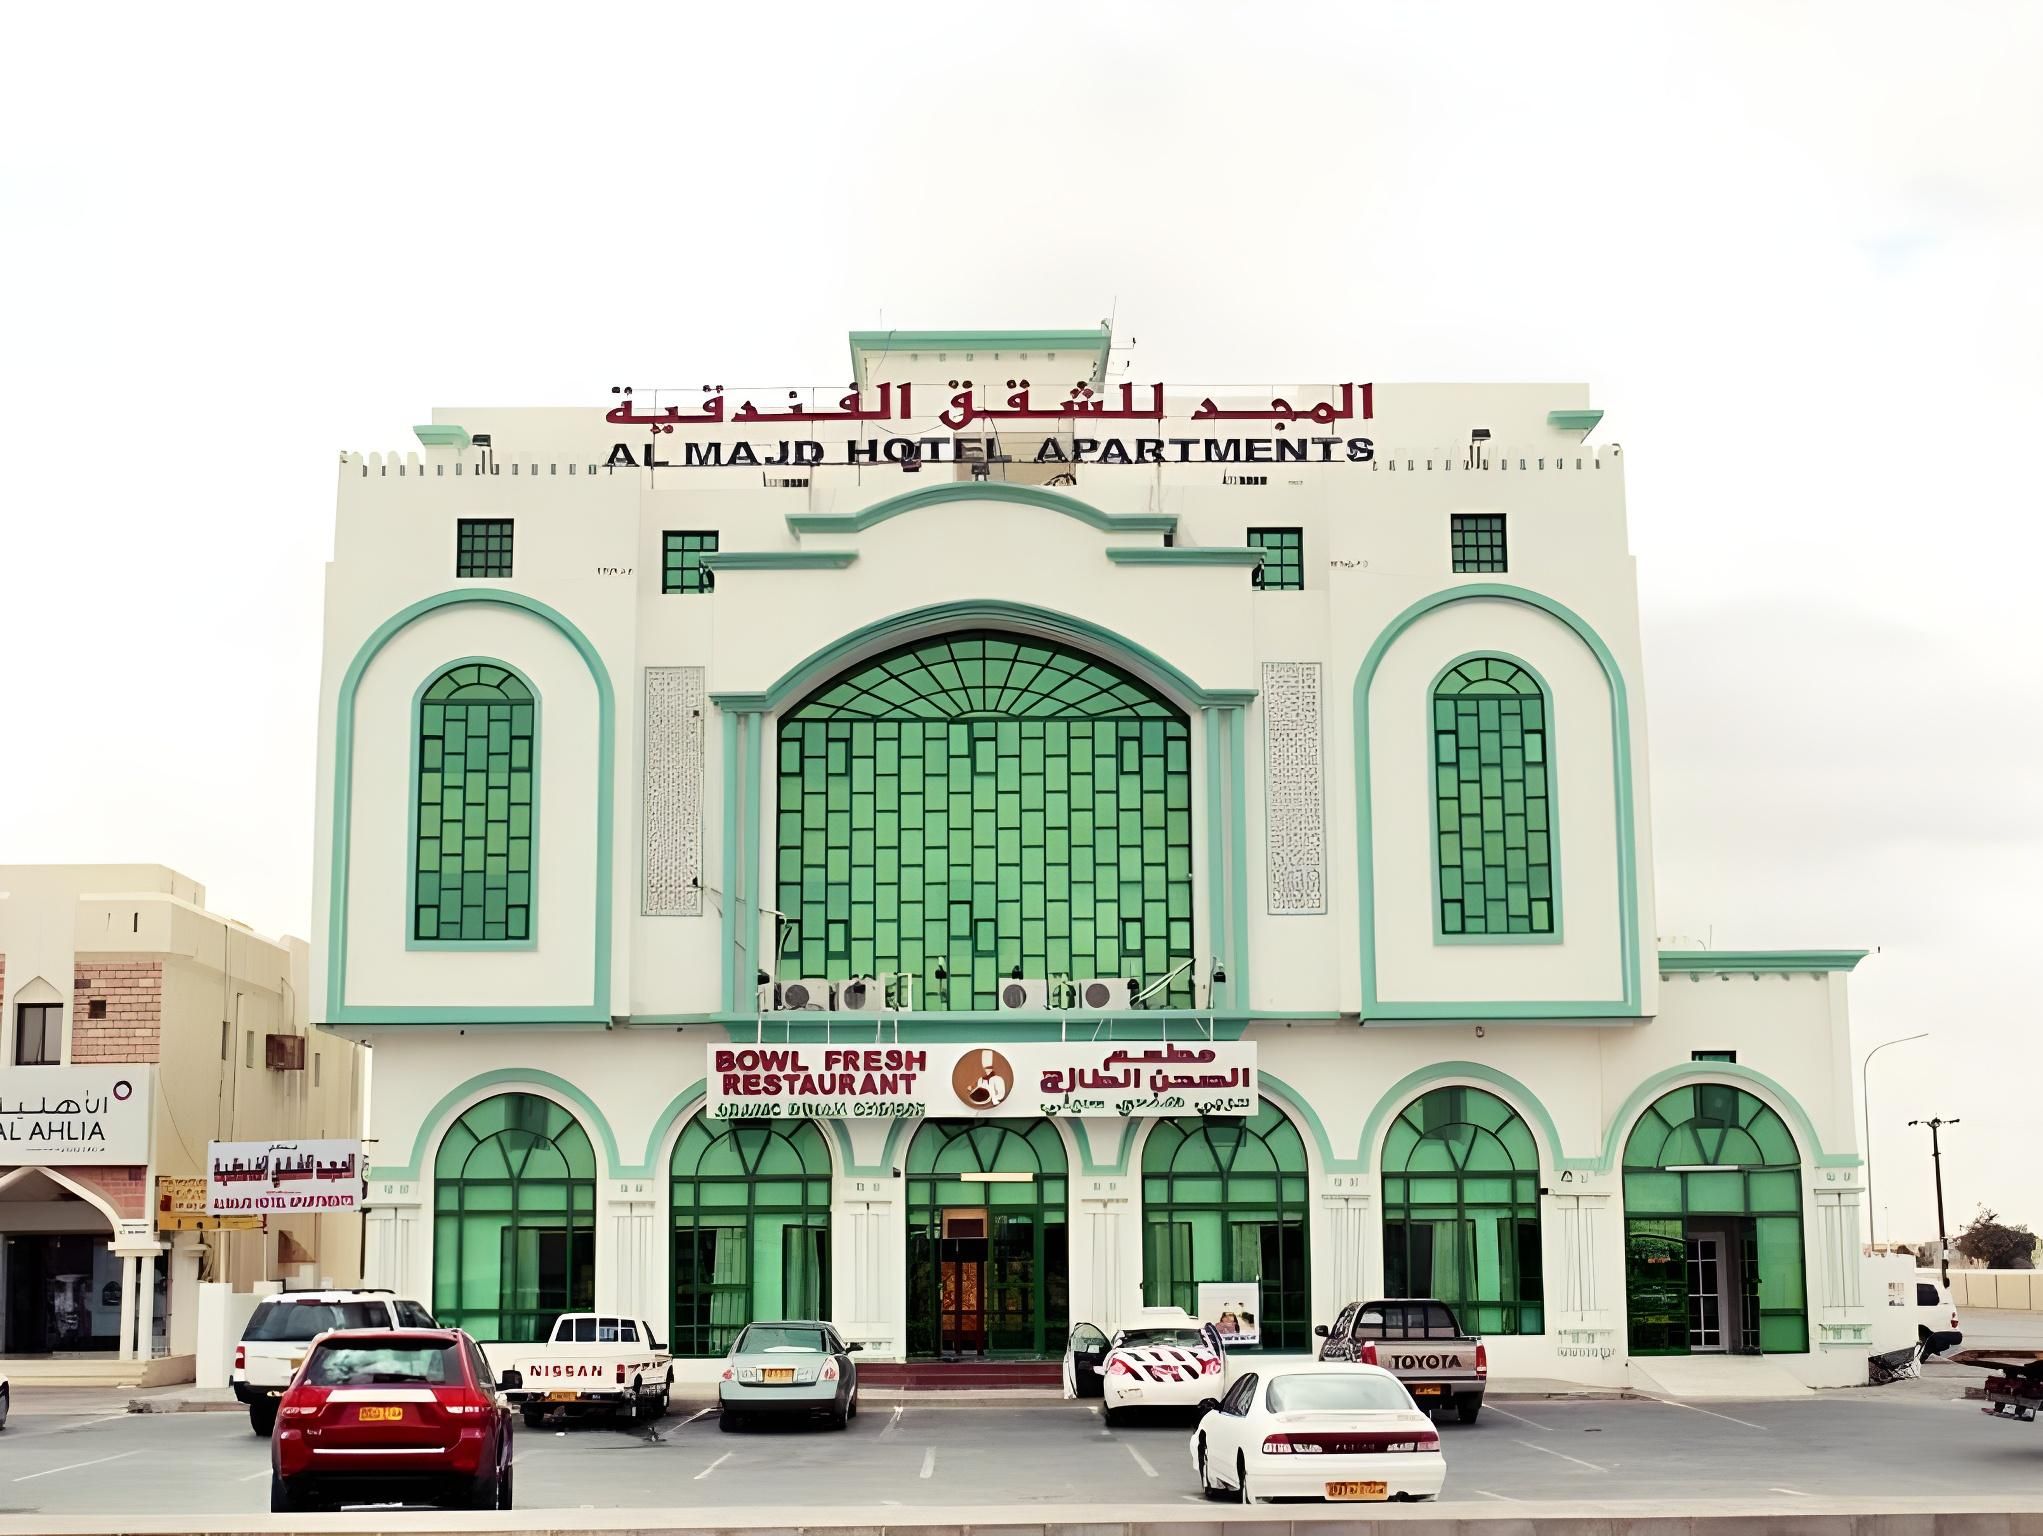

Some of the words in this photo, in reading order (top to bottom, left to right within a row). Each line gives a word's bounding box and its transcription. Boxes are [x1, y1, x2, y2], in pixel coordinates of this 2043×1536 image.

[606, 382, 911, 434] الفندقية
[938, 380, 1168, 430] للشقق
[1191, 382, 1373, 431] المجد
[606, 443, 669, 466] AL
[685, 440, 825, 466] MAJD
[847, 437, 1012, 466] HOTEL
[1036, 437, 1374, 463] APARTMENTS
[715, 1050, 809, 1072] BOWL
[824, 1050, 926, 1072] FRESH
[1103, 1043, 1216, 1071] مطعم
[722, 1073, 916, 1096] RESTAURANT
[28, 1121, 106, 1141] AHLIA
[530, 1365, 603, 1377] NISSAN
[1391, 1354, 1463, 1370] TOYOTA
